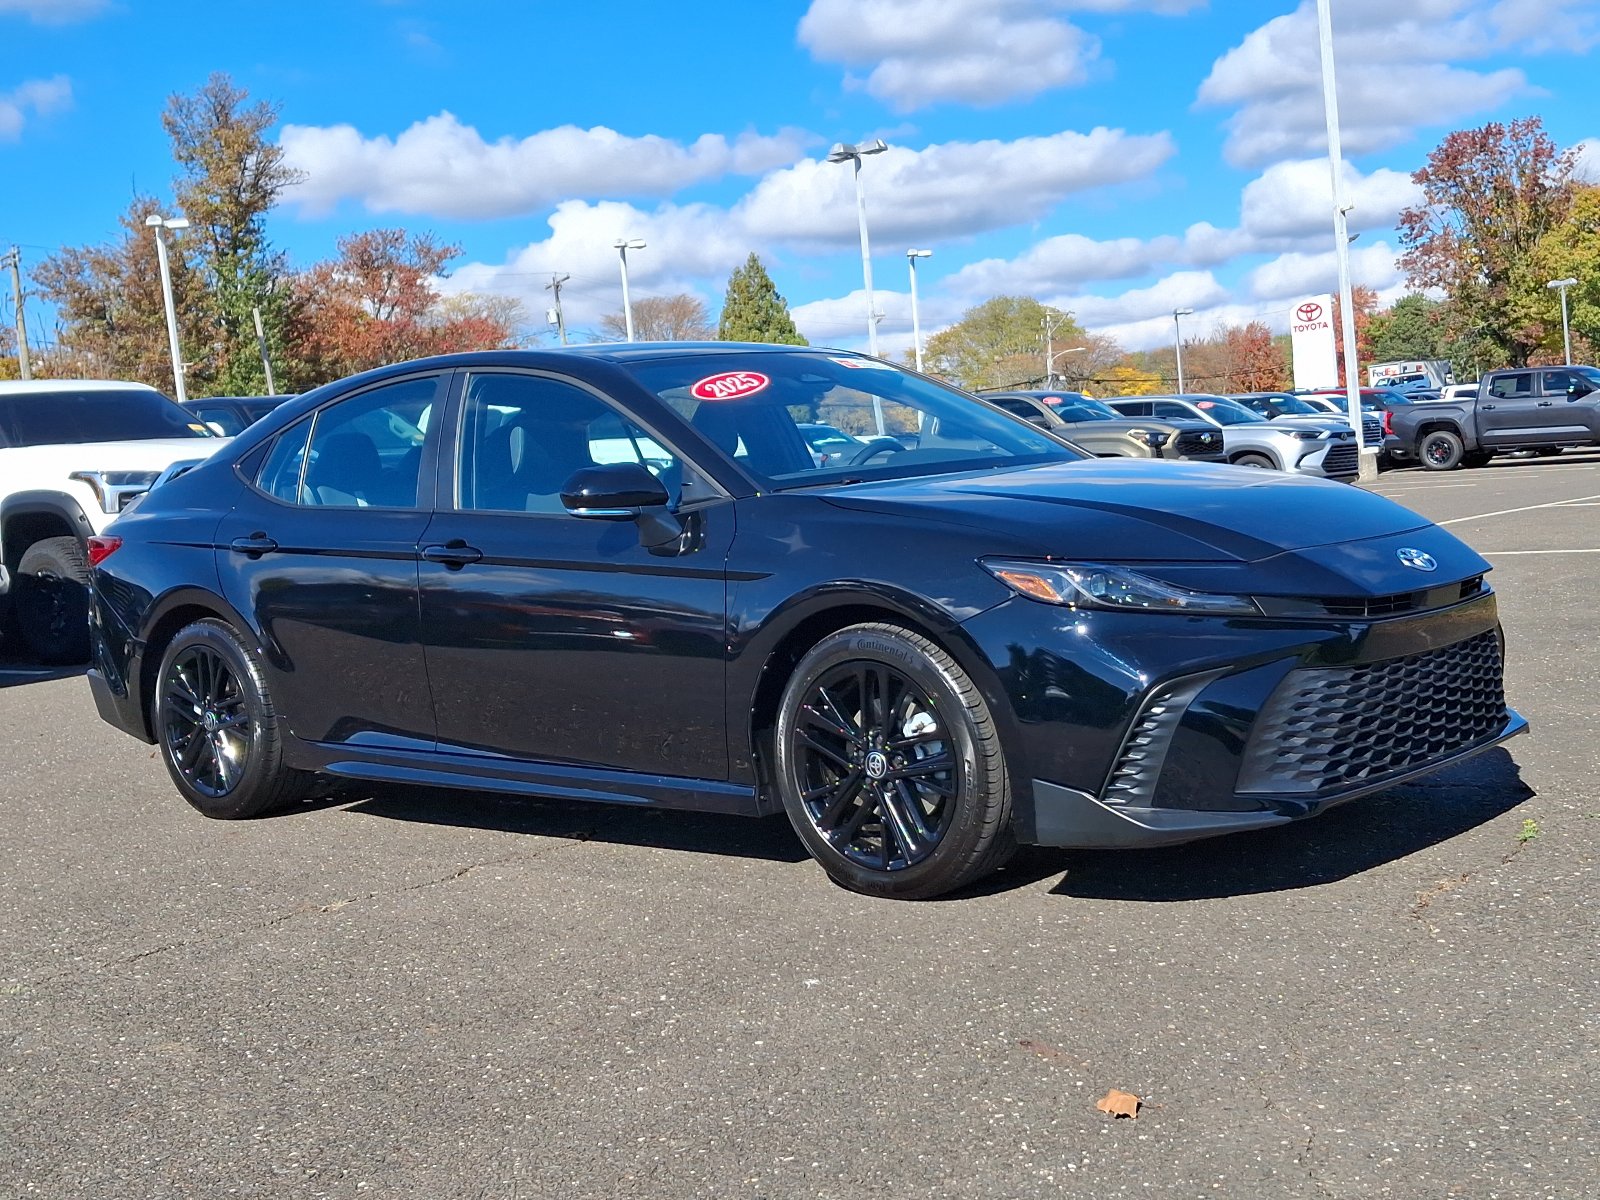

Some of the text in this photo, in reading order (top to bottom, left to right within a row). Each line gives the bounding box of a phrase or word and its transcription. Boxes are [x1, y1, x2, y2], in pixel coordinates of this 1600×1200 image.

[1293, 322, 1329, 332] TOYOTA
[1372, 367, 1397, 378] FedEx
[705, 373, 759, 398] 2025
[857, 638, 908, 662] Continental
